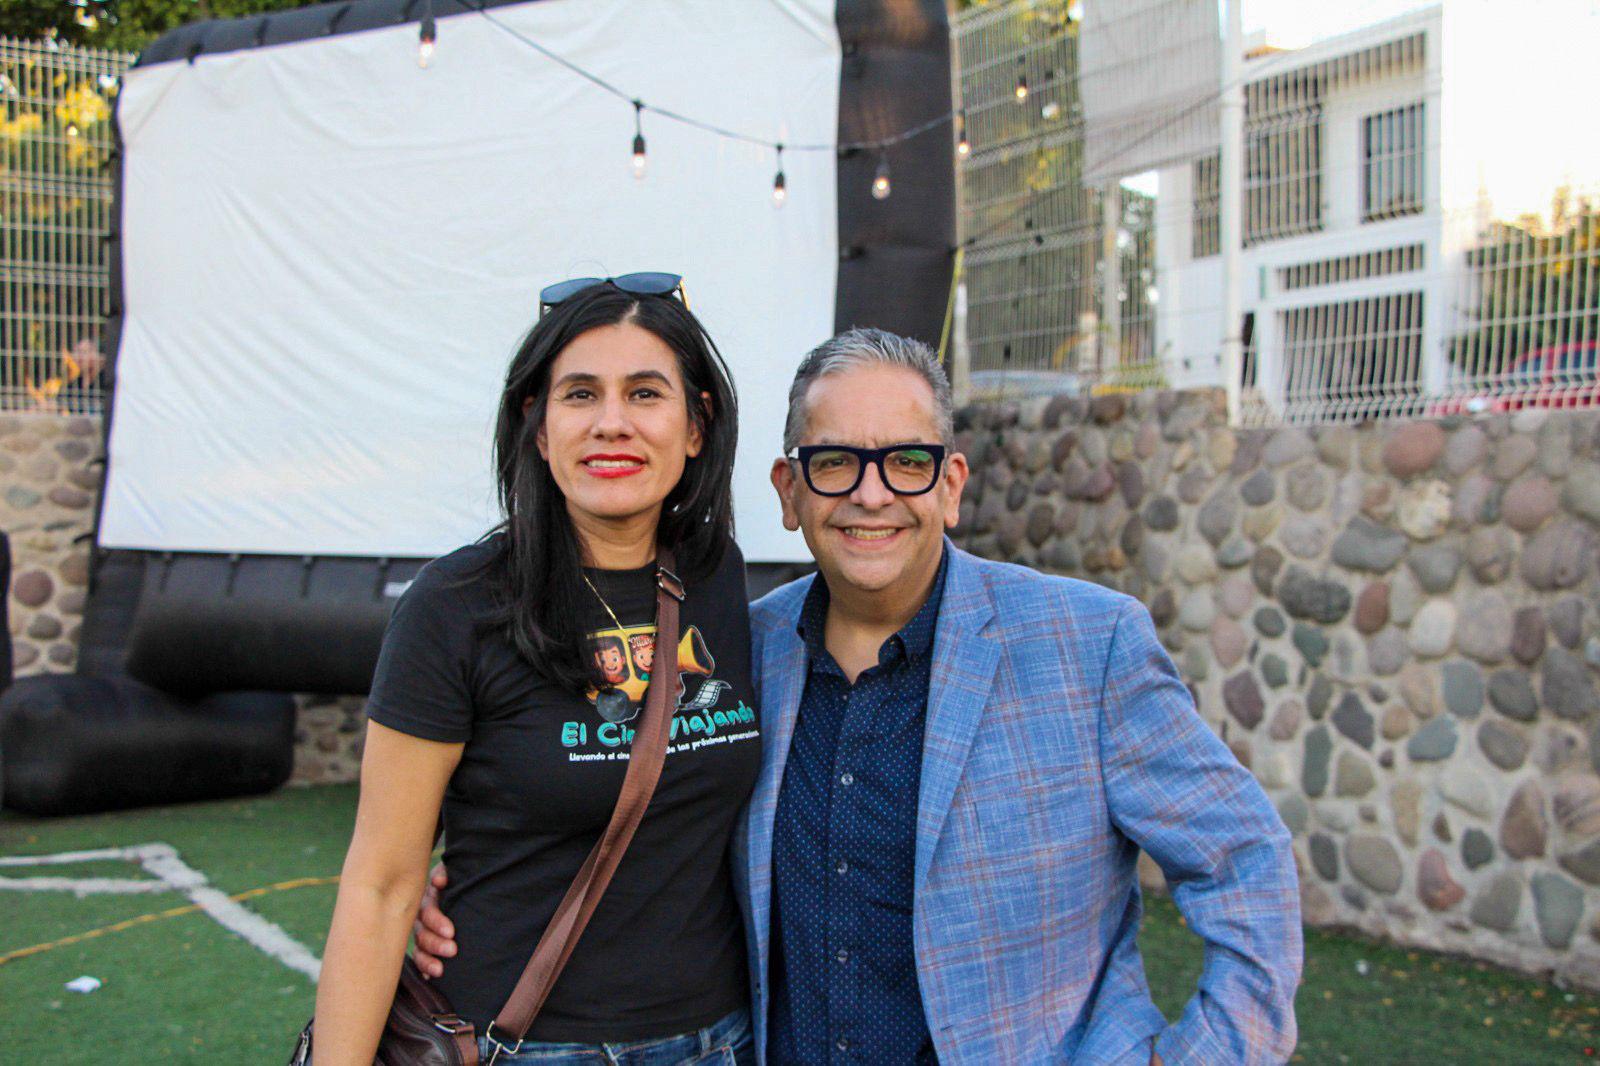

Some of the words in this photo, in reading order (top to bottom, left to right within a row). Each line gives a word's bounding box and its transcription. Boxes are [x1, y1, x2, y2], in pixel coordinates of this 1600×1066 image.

[561, 721, 587, 747] El
[597, 722, 636, 747] Cin
[569, 752, 606, 761] Llevando
[607, 752, 616, 760] el
[677, 743, 690, 751] las
[691, 735, 727, 751] próximas
